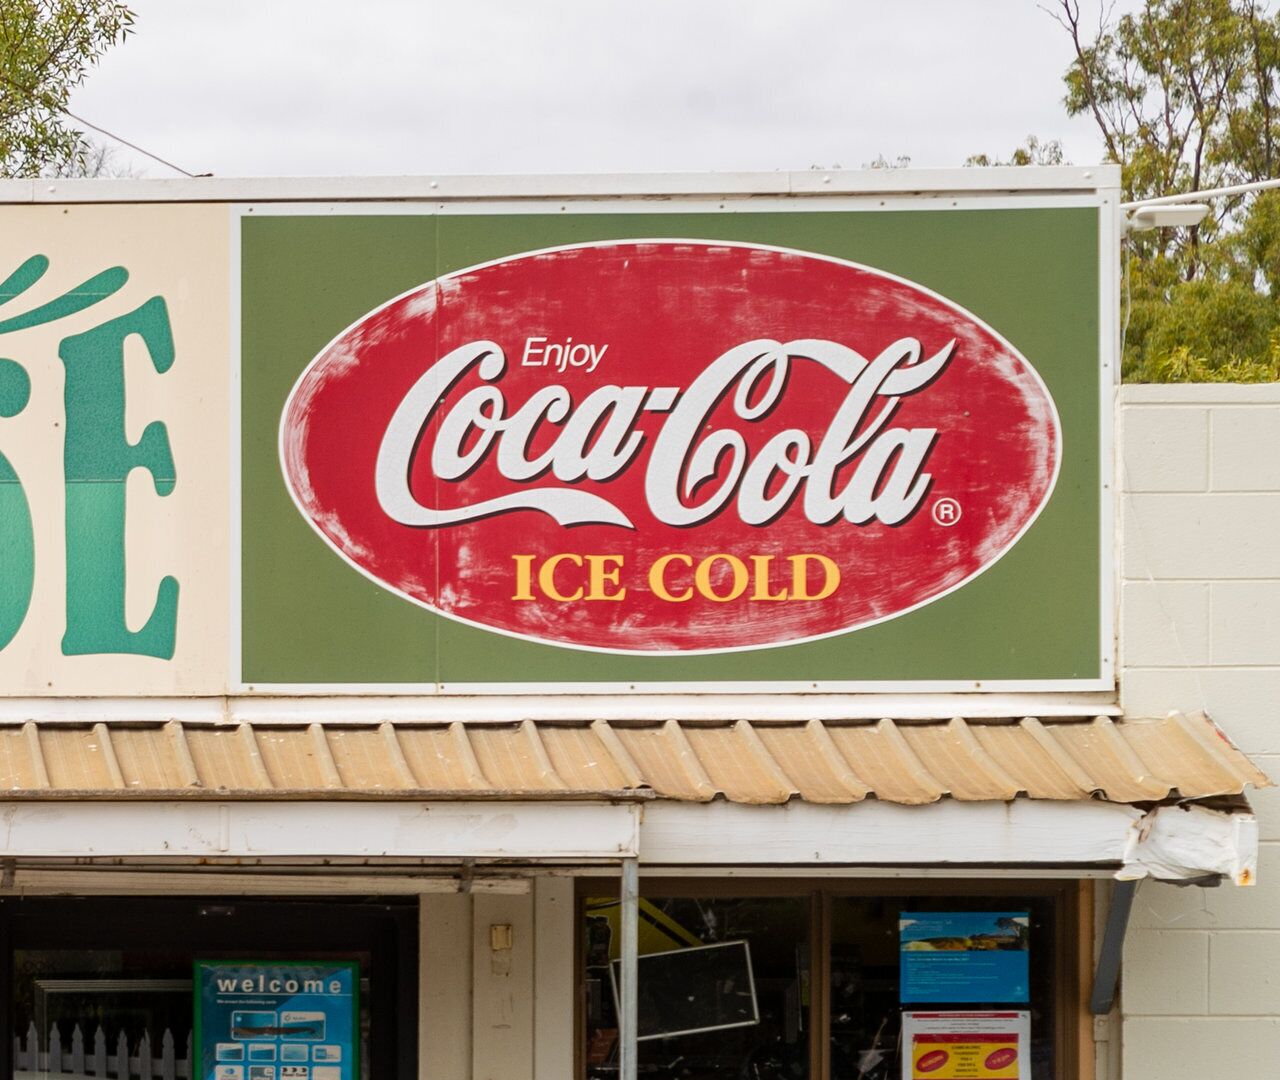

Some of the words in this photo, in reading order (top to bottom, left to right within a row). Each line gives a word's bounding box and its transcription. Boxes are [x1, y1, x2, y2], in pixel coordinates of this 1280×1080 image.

[521, 337, 609, 372] Enjoy
[375, 337, 958, 530] Coca-Cola
[512, 554, 626, 602] ICE
[648, 554, 841, 602] COLD
[217, 975, 341, 994] welcome
